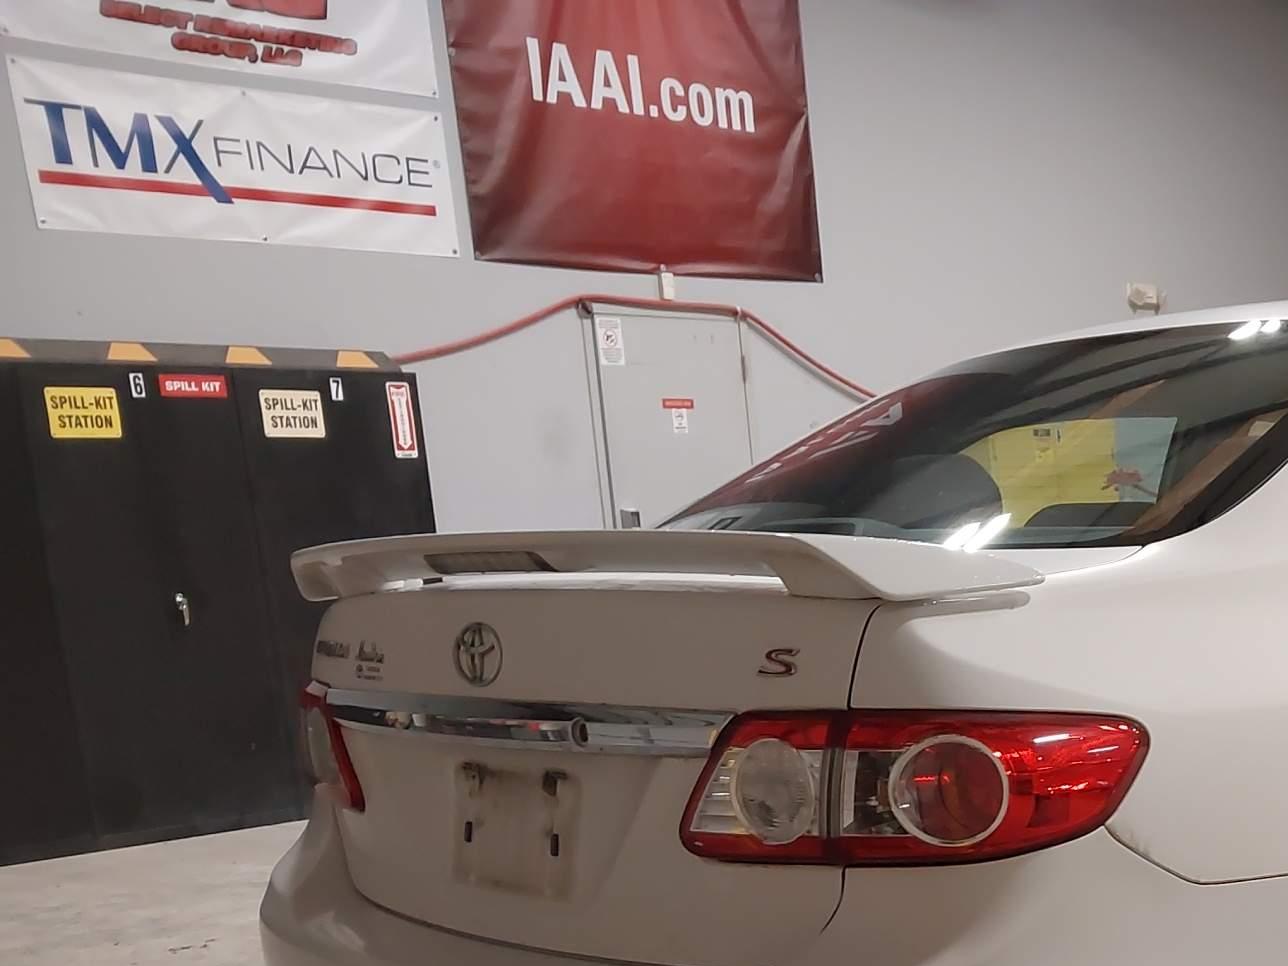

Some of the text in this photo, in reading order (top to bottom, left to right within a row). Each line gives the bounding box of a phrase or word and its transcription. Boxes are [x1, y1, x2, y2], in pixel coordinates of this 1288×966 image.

[525, 36, 756, 133] IAAI.com
[24, 97, 234, 204] TMX
[132, 374, 144, 396] 6
[165, 380, 221, 393] SPILL KIT
[331, 379, 340, 399] 7
[50, 395, 114, 410] SPILL-KIT
[264, 397, 319, 411] SPILL-KIT
[58, 415, 113, 429] STATION
[271, 415, 318, 429] STATION
[757, 648, 801, 678] S
